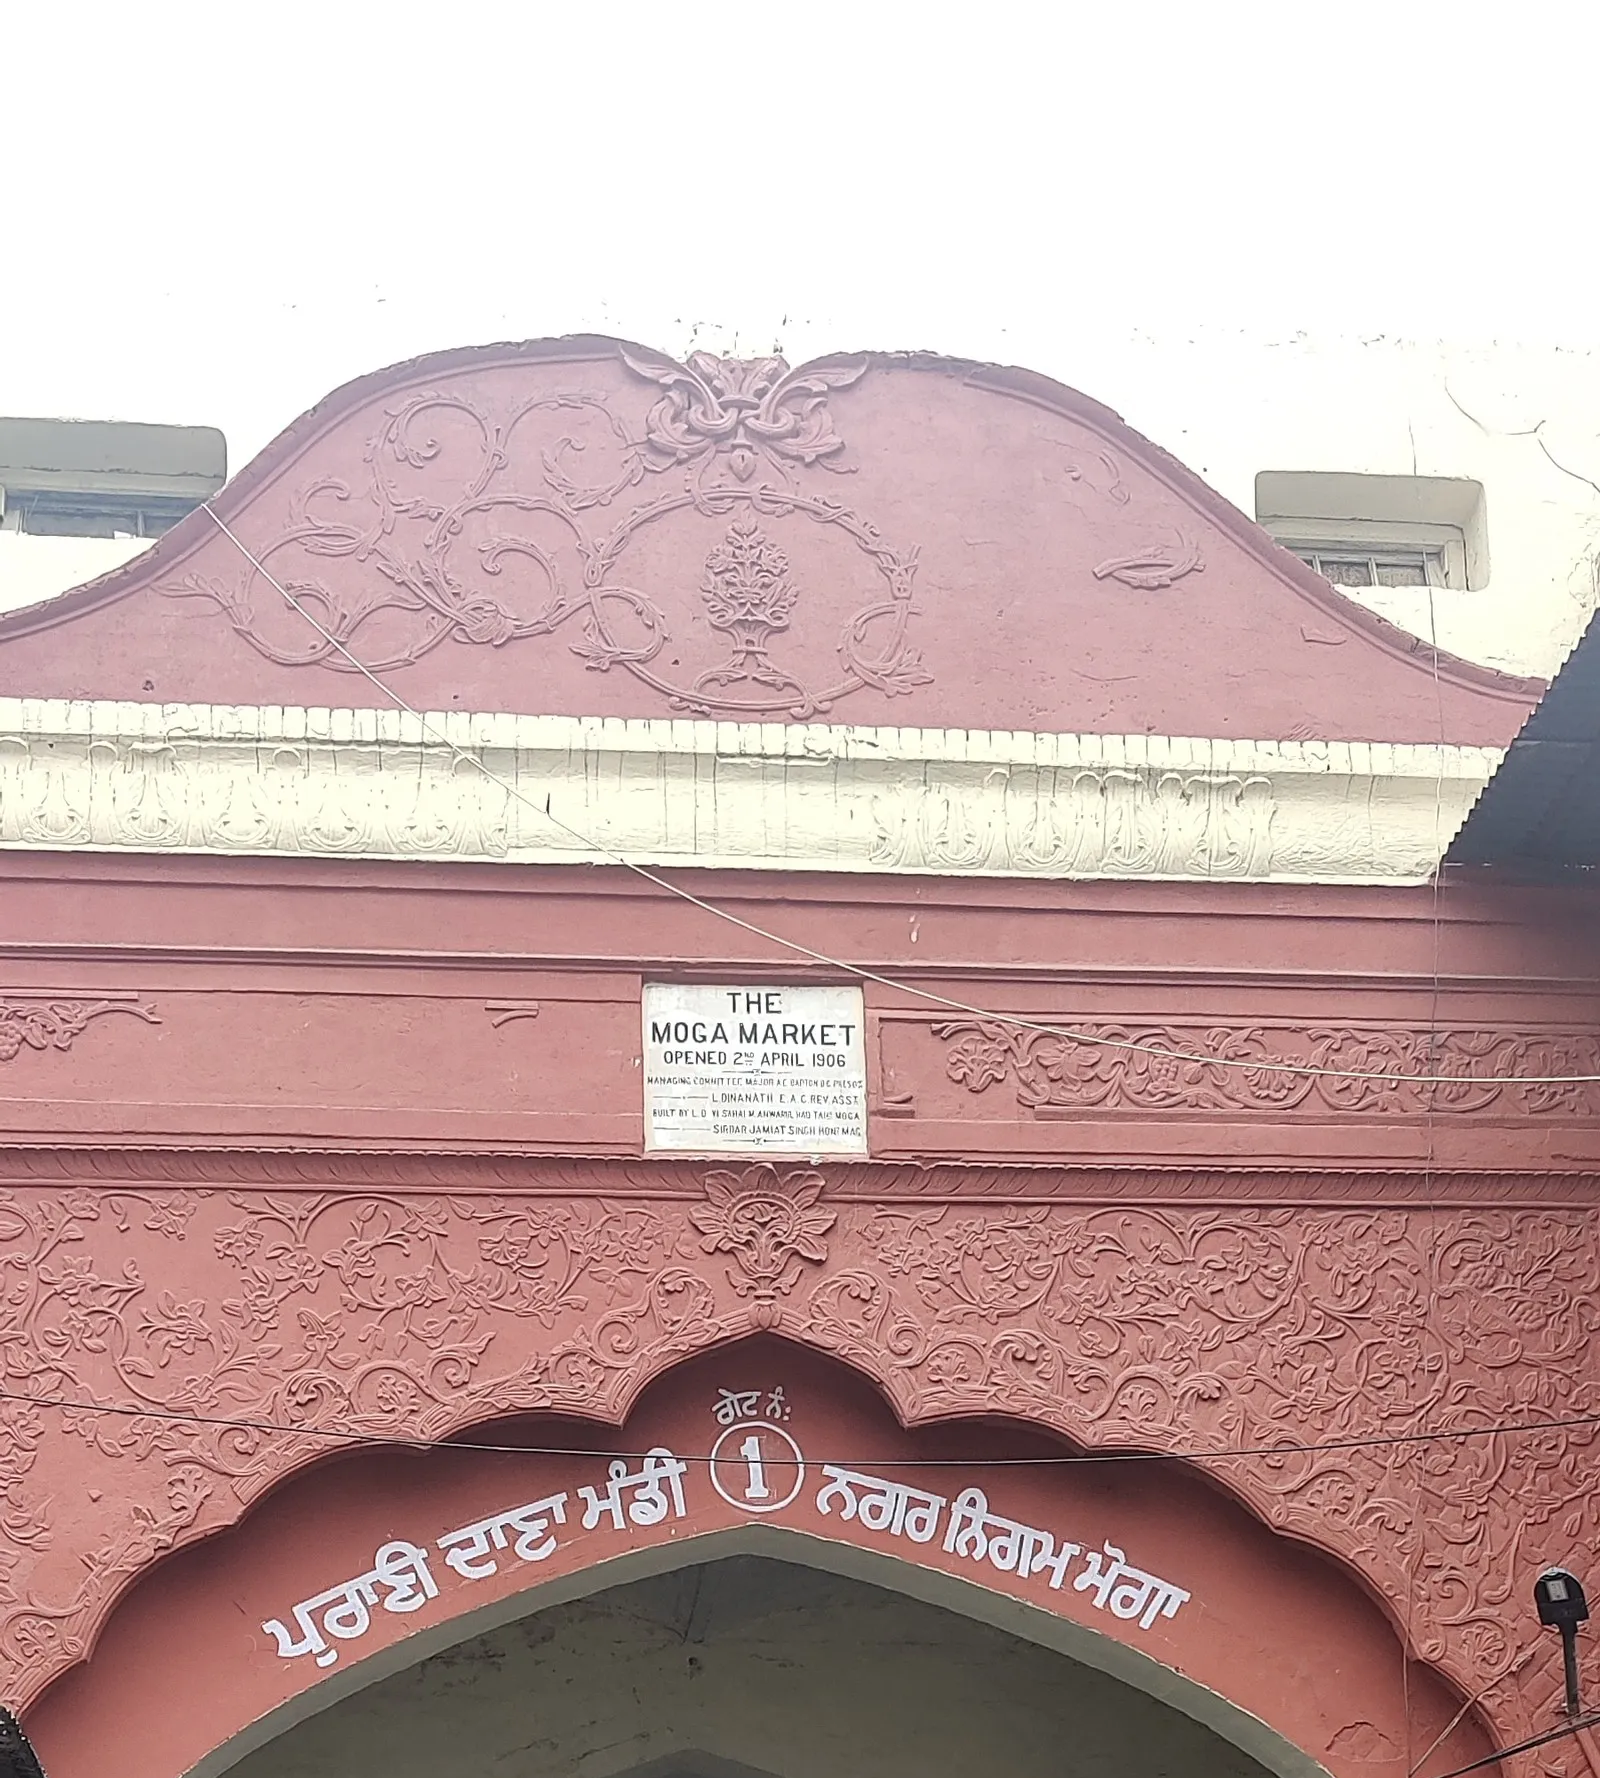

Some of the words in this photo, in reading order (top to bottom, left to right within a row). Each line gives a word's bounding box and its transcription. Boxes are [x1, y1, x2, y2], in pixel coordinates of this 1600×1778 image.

[727, 992, 782, 1014] THE
[652, 1022, 729, 1044] MOGA
[739, 1022, 856, 1046] MARKET
[663, 1051, 727, 1065] OPENED
[760, 1052, 804, 1067] APRIL
[812, 1053, 846, 1067] 1906
[647, 1076, 691, 1085] MANAGING
[745, 1078, 774, 1086] MAJOR
[653, 1108, 676, 1118] BUILT
[713, 1124, 747, 1134] SIRDAR
[749, 1125, 786, 1135] JAMIAT
[788, 1125, 816, 1136] SINGH
[711, 1388, 762, 1425] ਗੇਟ
[740, 1436, 770, 1498] 1
[436, 1491, 569, 1580] ਦਾਣਾ
[577, 1447, 689, 1531] ਮੰਡੀ
[816, 1464, 947, 1543] ਨਗਰ
[942, 1487, 1080, 1590] ਨਿਗਮ
[1073, 1539, 1191, 1630] ਮੋਗਾ
